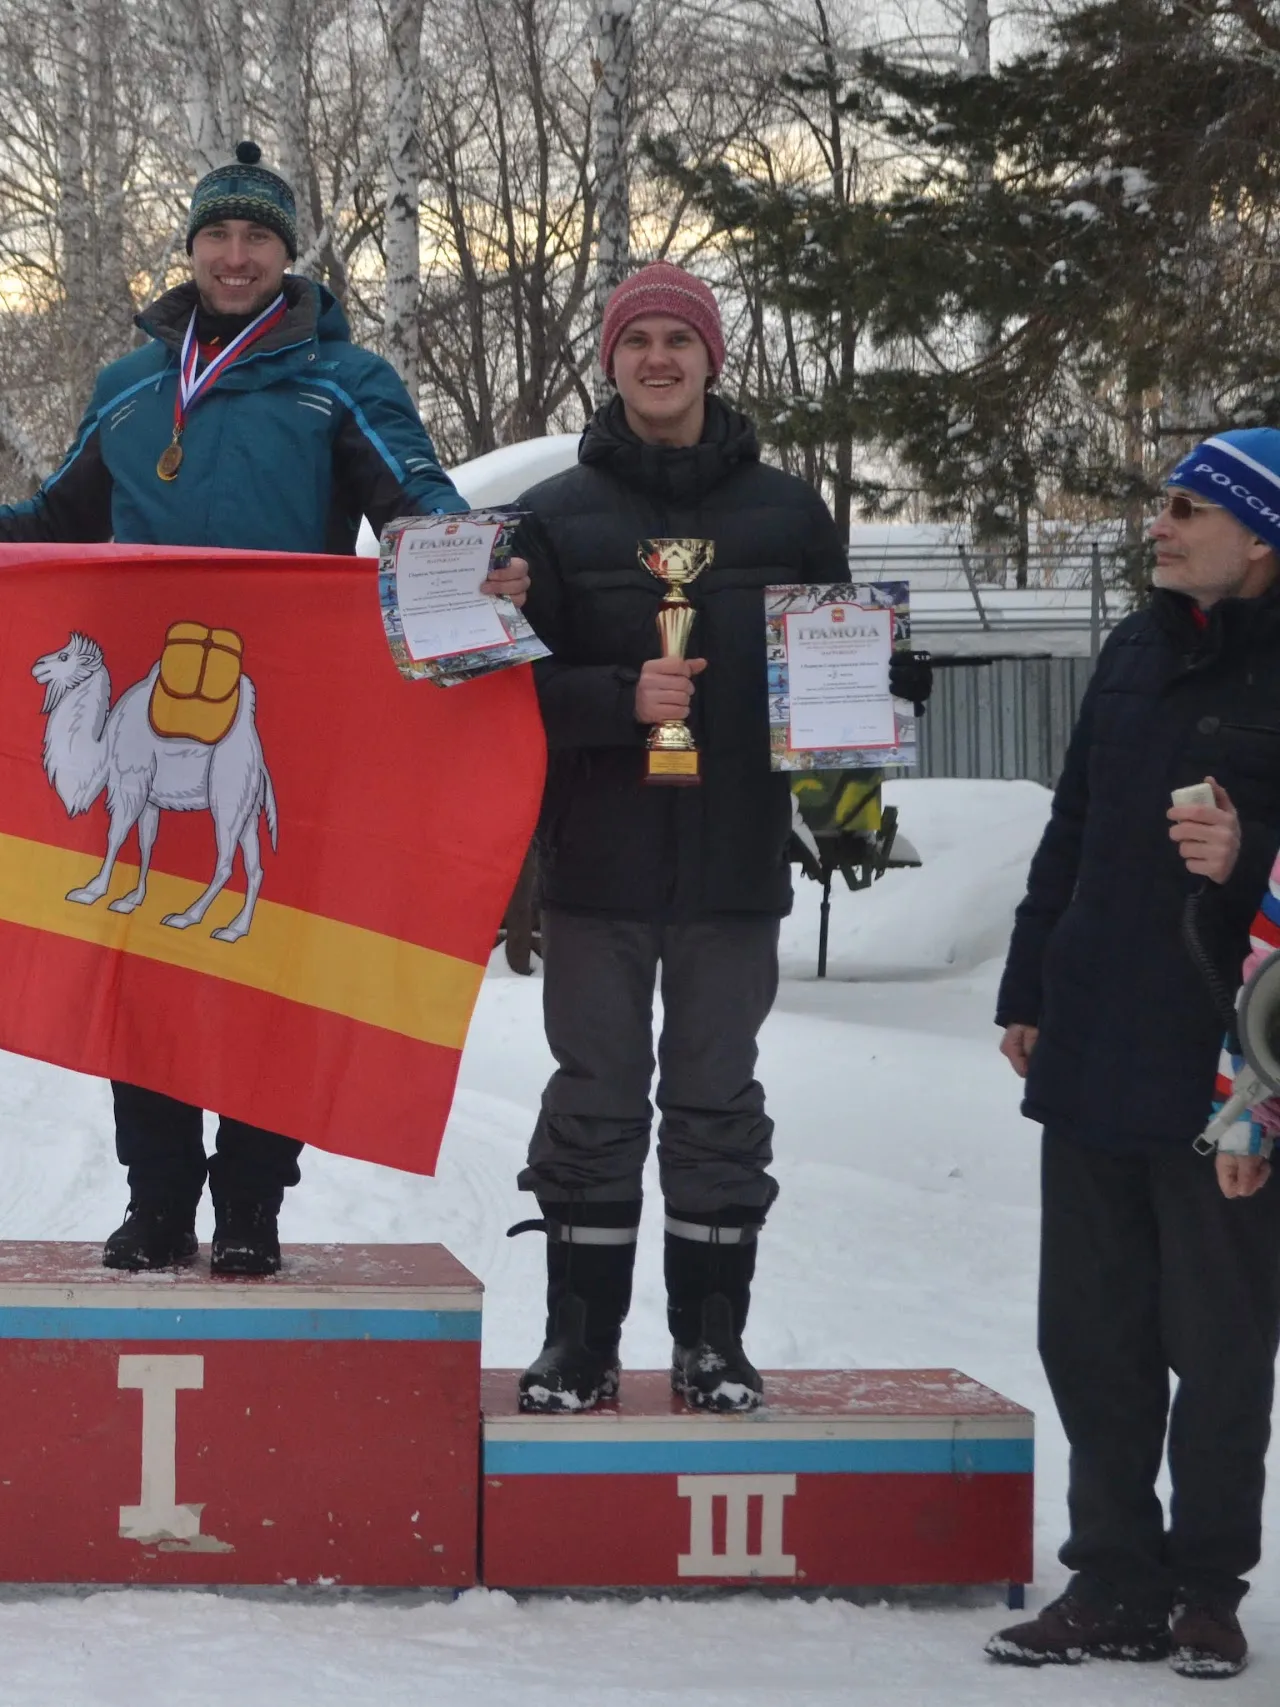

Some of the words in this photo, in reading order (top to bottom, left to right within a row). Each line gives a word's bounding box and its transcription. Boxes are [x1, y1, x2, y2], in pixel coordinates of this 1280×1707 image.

[1194, 463, 1280, 528] РОССИ
[409, 536, 484, 551] ГРАМОТА
[798, 624, 880, 640] ГРАМОТА
[118, 1354, 204, 1540] I
[677, 1473, 797, 1577] III
